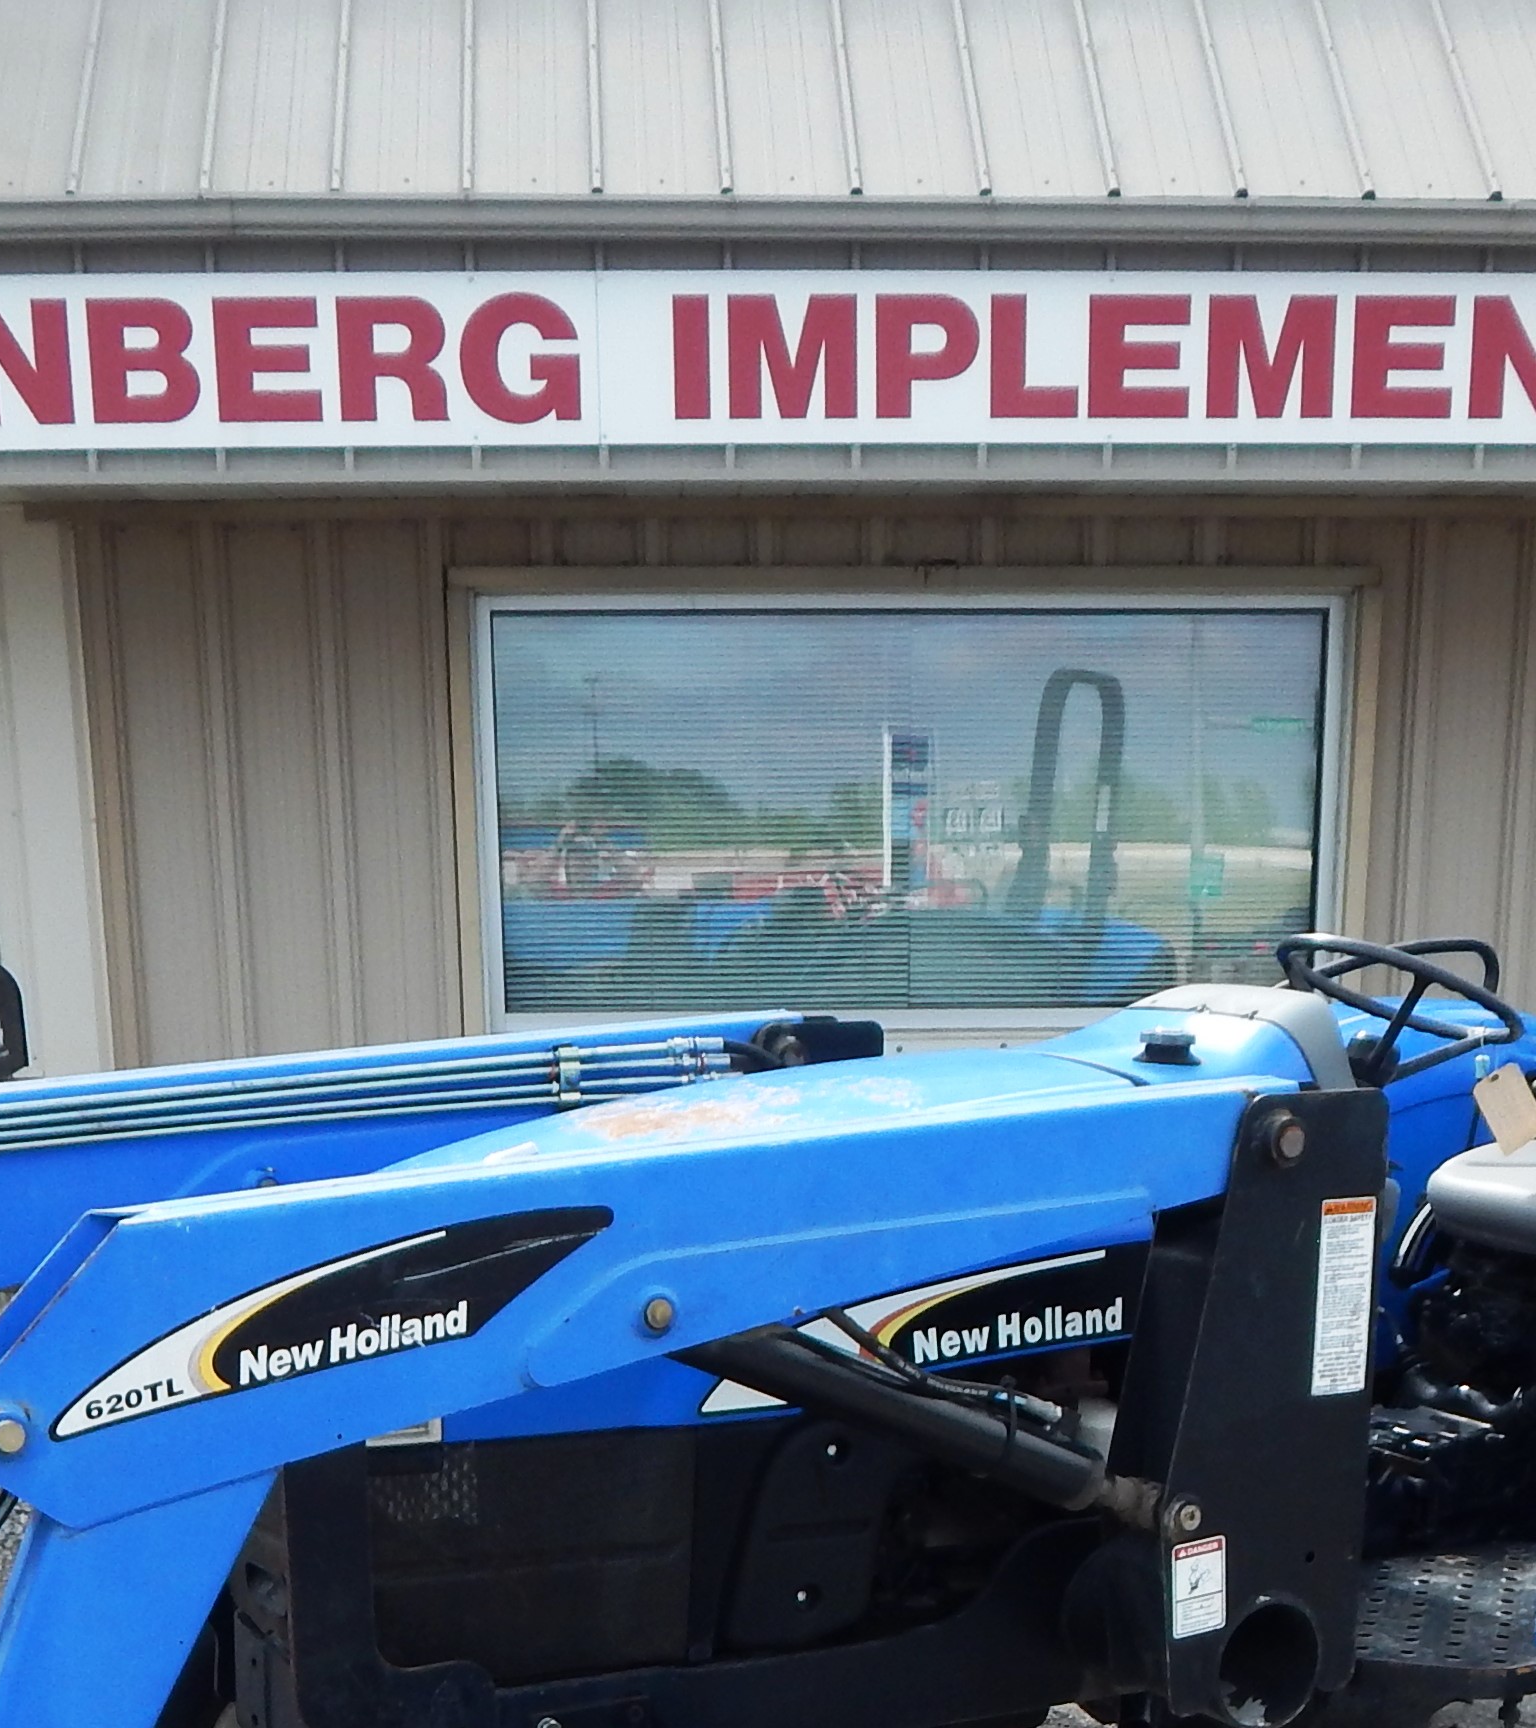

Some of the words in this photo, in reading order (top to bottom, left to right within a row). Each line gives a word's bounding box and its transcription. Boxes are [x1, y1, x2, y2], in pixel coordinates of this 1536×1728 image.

[239, 1340, 324, 1386] New
[329, 1300, 467, 1363] Holland
[913, 1326, 990, 1364] New
[997, 1297, 1123, 1349] Holland
[85, 1378, 184, 1420] 620TL
[1187, 1541, 1219, 1556] DANGER
